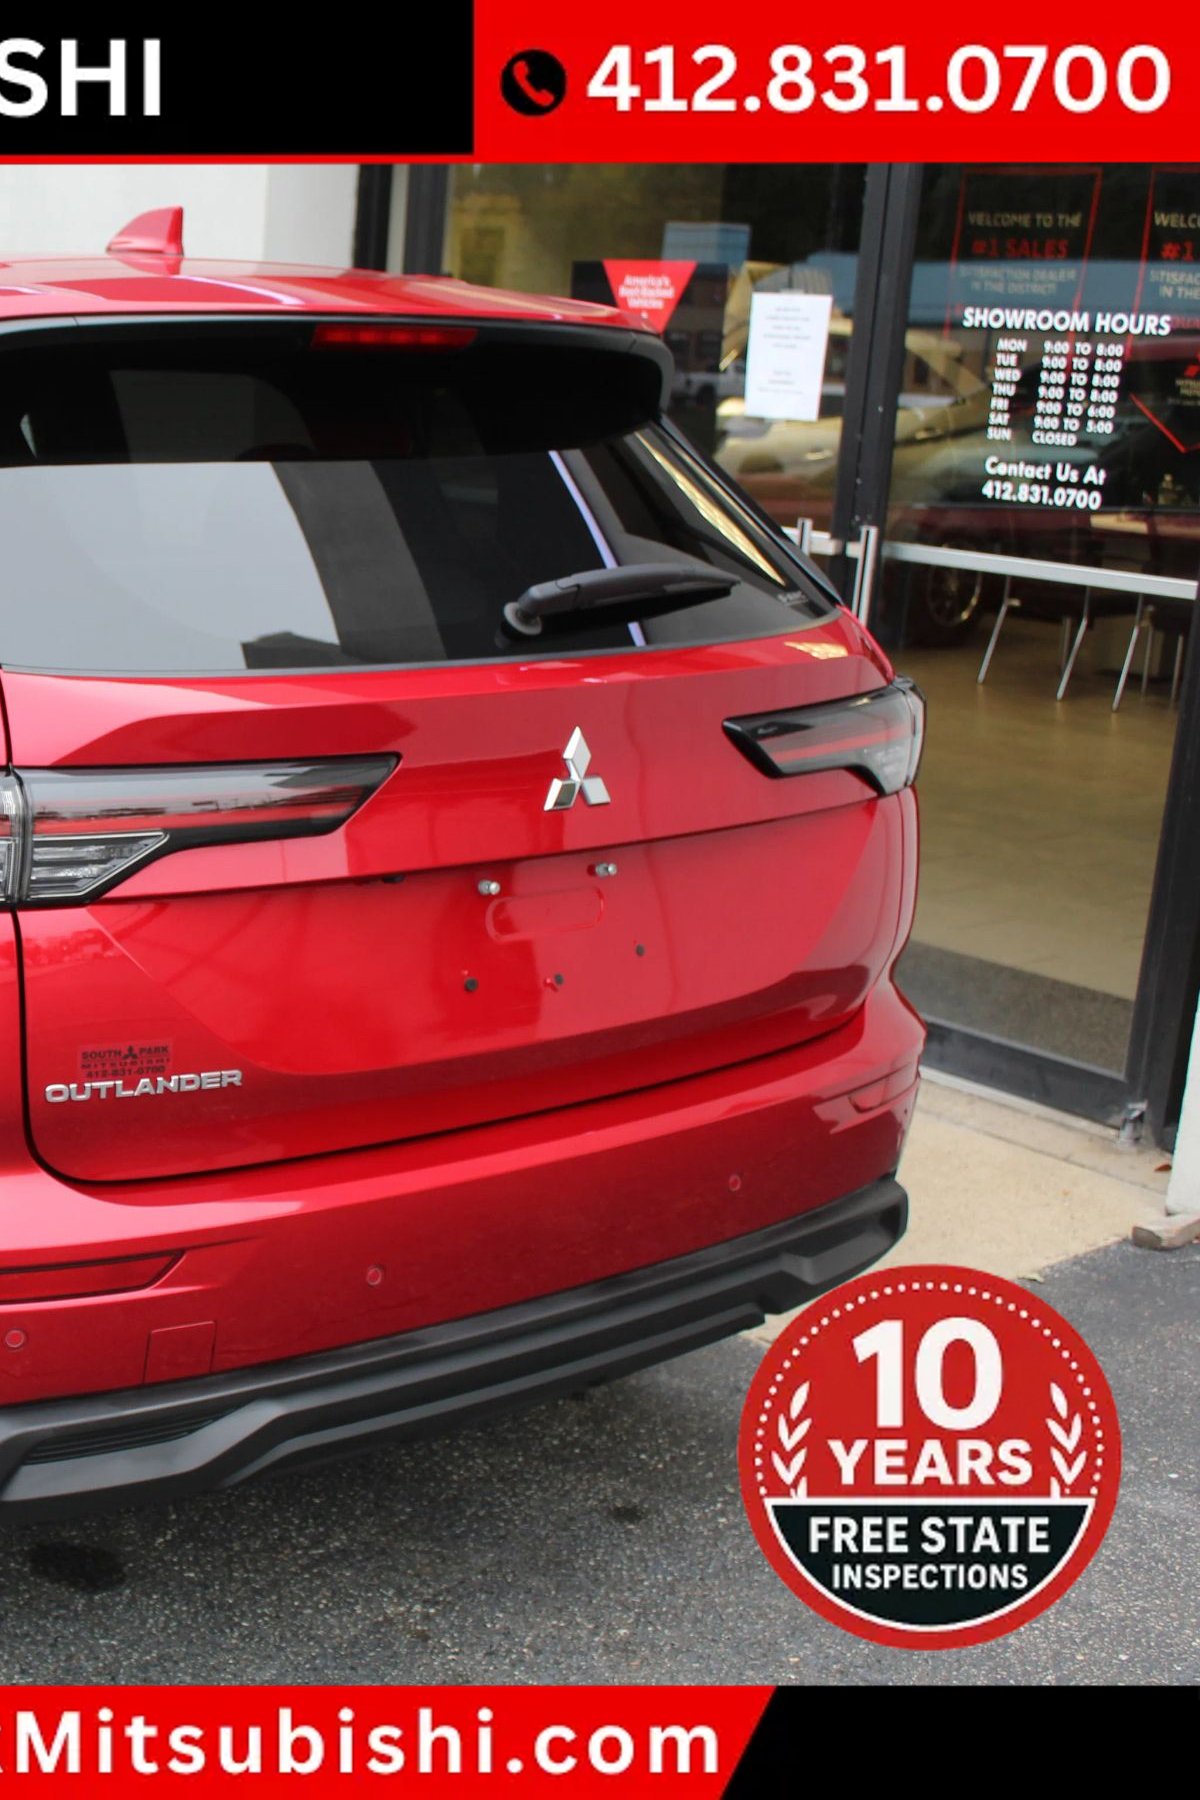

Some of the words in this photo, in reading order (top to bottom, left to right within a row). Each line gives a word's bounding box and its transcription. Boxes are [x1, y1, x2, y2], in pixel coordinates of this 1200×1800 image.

[1006, 239, 1069, 259] SALES
[1161, 242, 1195, 261] #1
[962, 306, 1090, 332] SHOWROOM
[1094, 312, 1172, 336] HOURS
[996, 338, 1028, 352] MON
[1075, 342, 1092, 356] TO
[1096, 343, 1124, 357] 8:00
[996, 353, 1018, 367] TUE
[1072, 357, 1089, 371] TO
[1094, 358, 1122, 373] 8:00
[994, 367, 1022, 382] WED
[1070, 372, 1088, 387] TO
[1091, 373, 1120, 389] 8:00
[992, 382, 1017, 397] THU
[1069, 387, 1086, 402] TO
[1090, 389, 1118, 404] 8:00
[990, 397, 1010, 411] FRI
[1066, 402, 1084, 417] TO
[988, 411, 1011, 426] SAT
[1063, 416, 1081, 432] TO
[986, 426, 1013, 442] SUN
[1031, 430, 1078, 447] CLOSED
[984, 455, 1053, 480] Contact
[1055, 462, 1080, 484] Us
[1082, 465, 1107, 486] At
[981, 479, 1103, 510] 412.831.0700
[81, 1049, 122, 1060] SOUTH
[139, 1045, 169, 1055] PARK
[44, 1068, 243, 1103] OUTLANDER
